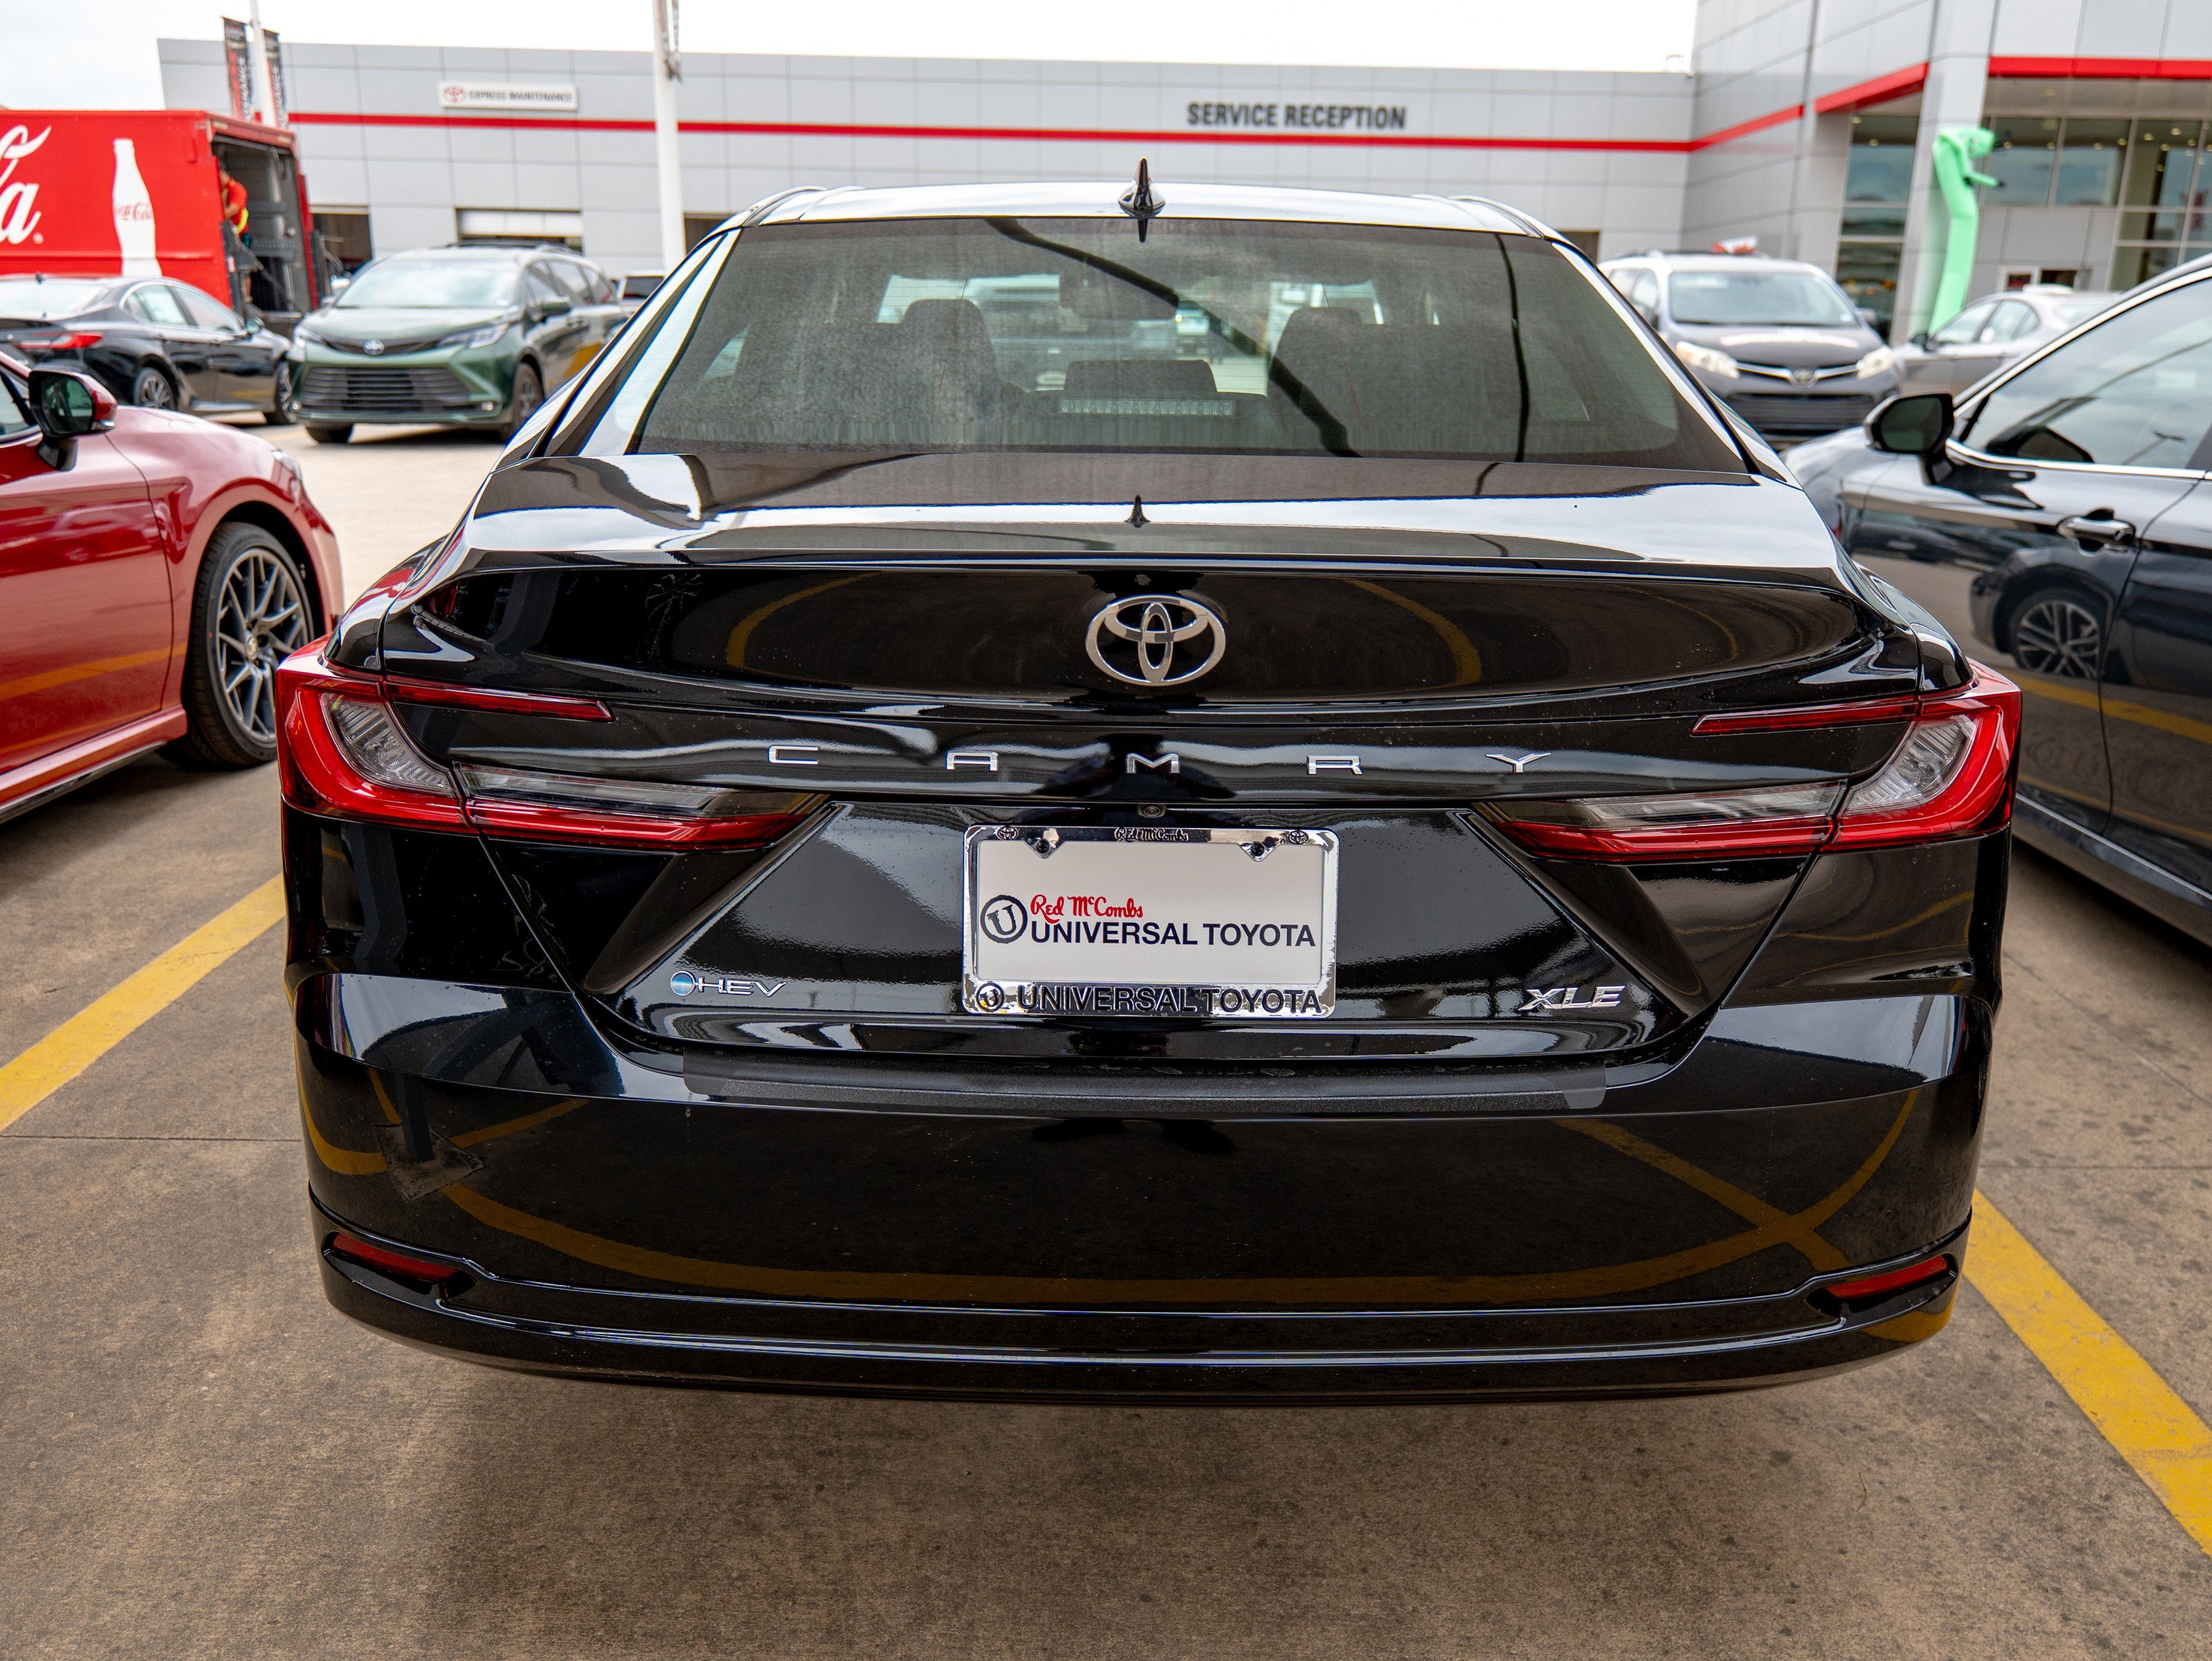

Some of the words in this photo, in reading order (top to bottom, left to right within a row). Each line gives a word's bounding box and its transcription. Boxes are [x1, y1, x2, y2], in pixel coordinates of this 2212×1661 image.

[469, 90, 506, 101] EXPRESS
[509, 91, 572, 103] MAINTENANCE
[1187, 103, 1278, 127] SERVICE
[1284, 104, 1406, 130] RECEPTION
[769, 746, 1551, 775] CAMRY
[1115, 827, 1138, 842] Red
[1031, 894, 1065, 924] Red
[1067, 896, 1143, 918] McCombs
[1032, 921, 1198, 945] UNIVERSAL
[1202, 923, 1316, 947] TOYOTA
[698, 976, 787, 997] HEV
[1017, 985, 1198, 1012] UNIVERSAL
[1200, 987, 1323, 1013] TOYOTA
[1518, 985, 1626, 1011] XLE
